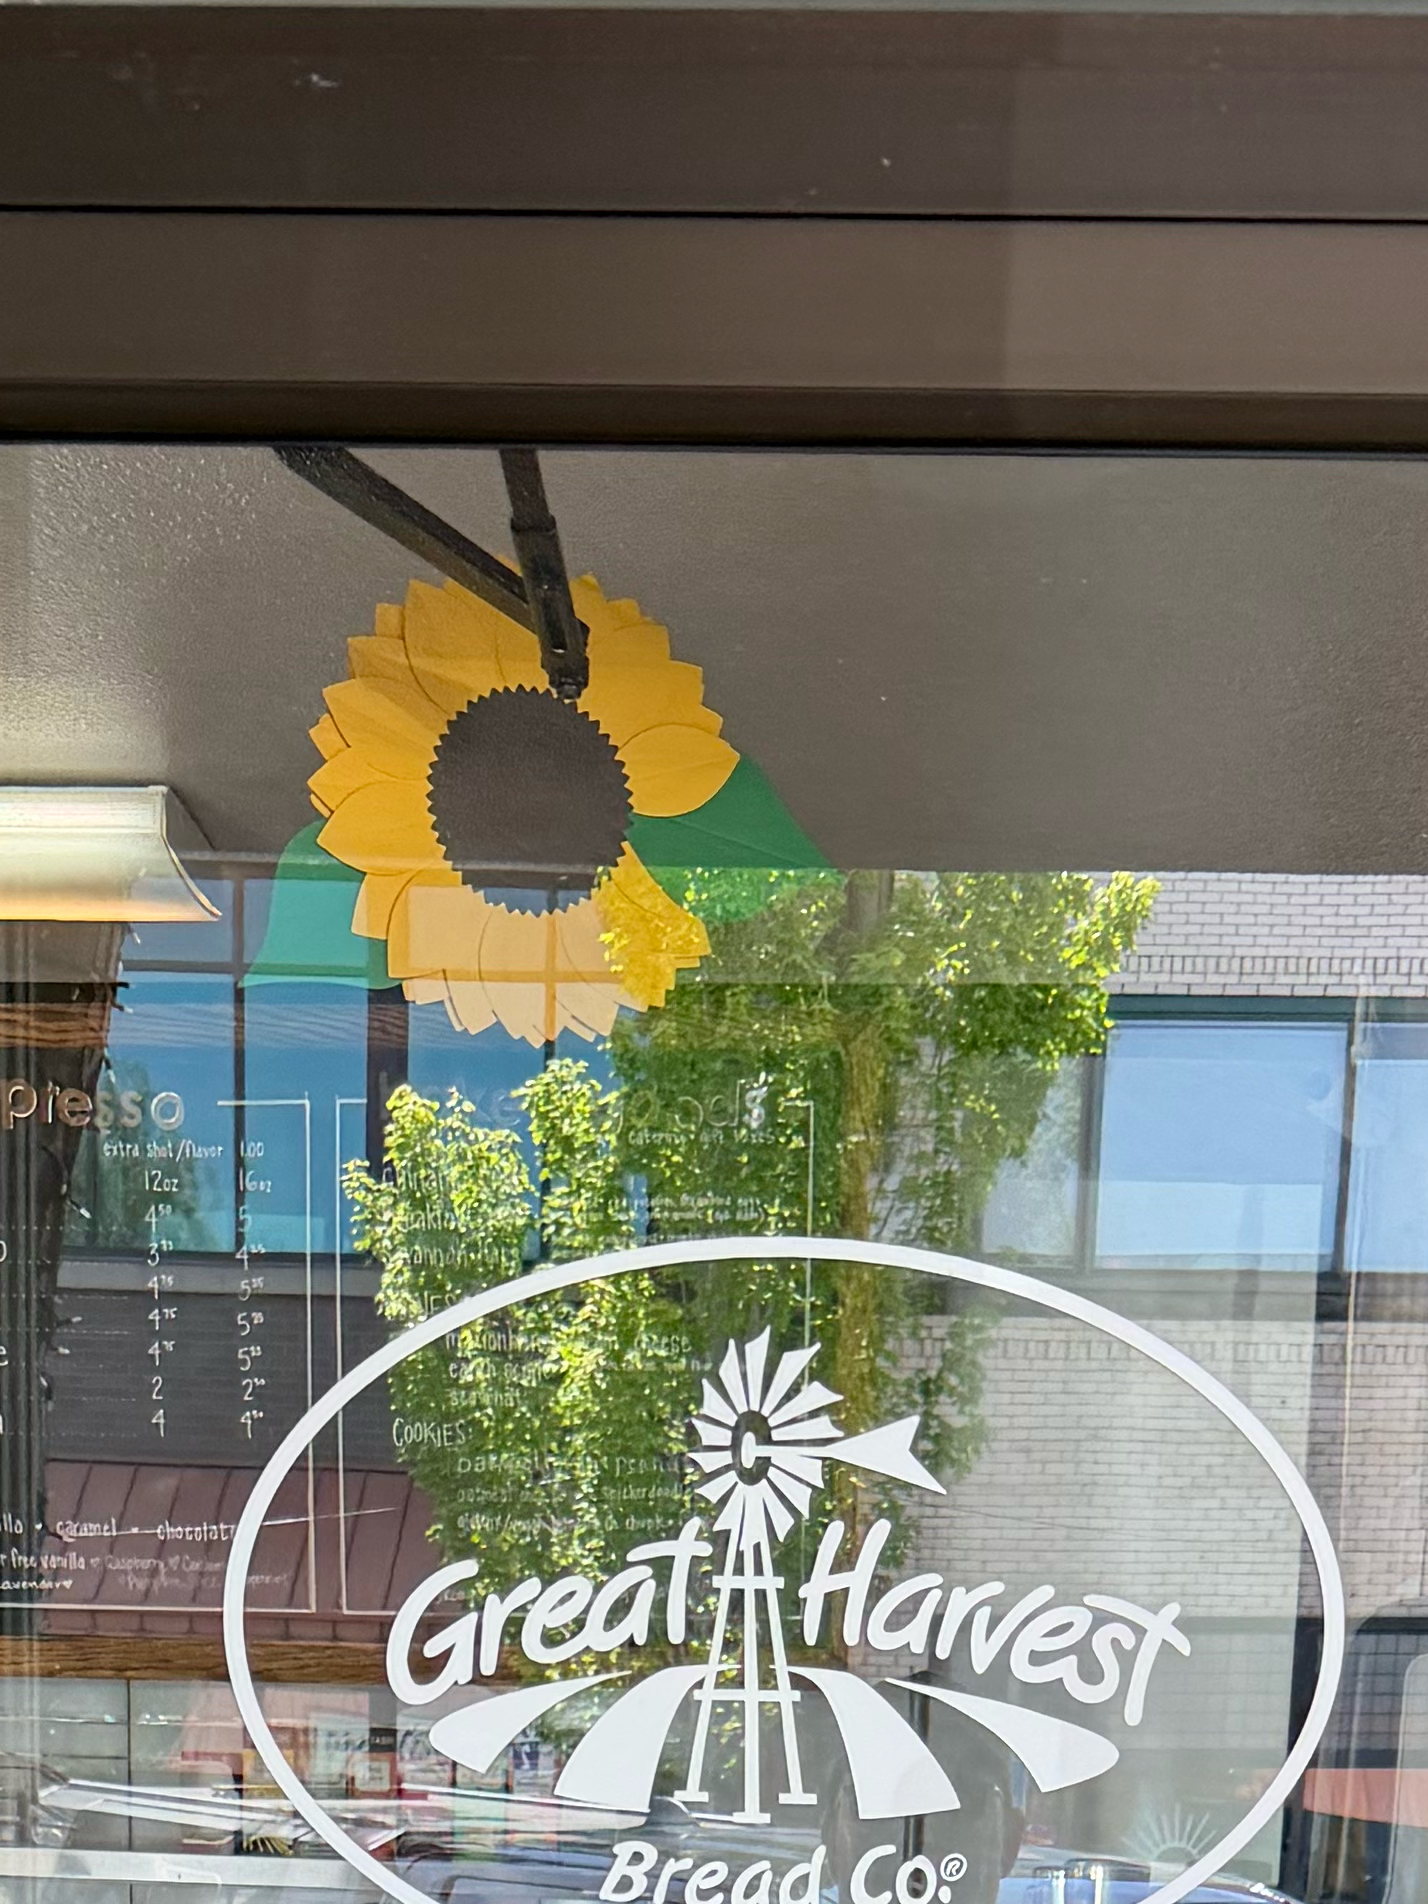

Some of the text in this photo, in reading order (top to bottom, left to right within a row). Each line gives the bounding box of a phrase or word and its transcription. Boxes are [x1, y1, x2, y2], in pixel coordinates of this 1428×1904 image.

[103, 1140, 139, 1158] extra
[144, 1167, 272, 1194] 12oz 16oz
[151, 1376, 164, 1400] 2
[150, 1409, 166, 1438] 4
[56, 1516, 117, 1538] caramel
[11, 1547, 38, 1569] free
[39, 1550, 86, 1570] vanilla
[385, 1516, 1191, 1727] Great Harvest
